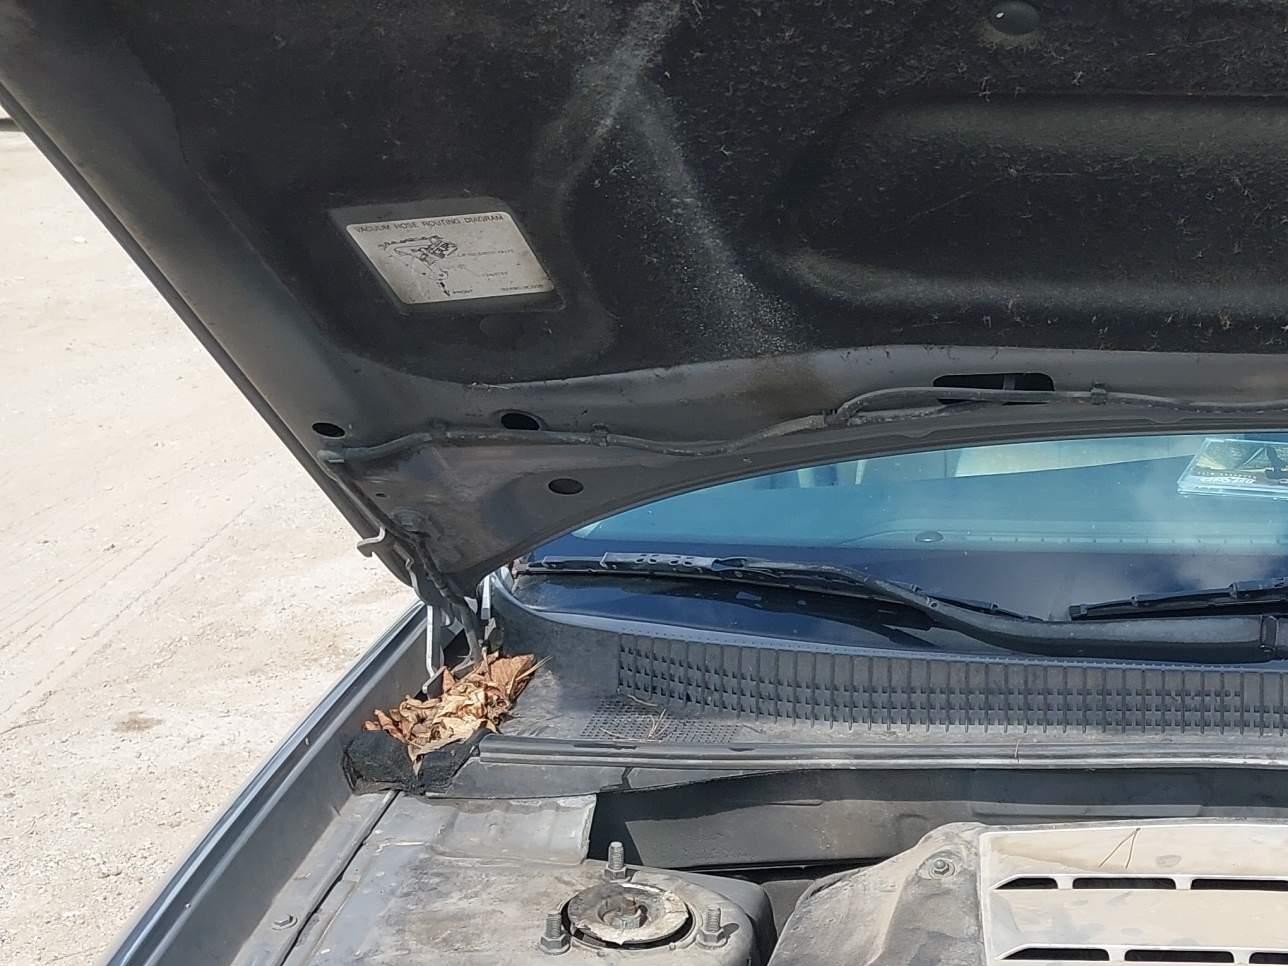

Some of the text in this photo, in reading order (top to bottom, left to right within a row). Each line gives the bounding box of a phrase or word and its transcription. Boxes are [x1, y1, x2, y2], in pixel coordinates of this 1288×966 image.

[355, 214, 505, 233] VACUUM HOSE ROUTING DIAGRAM
